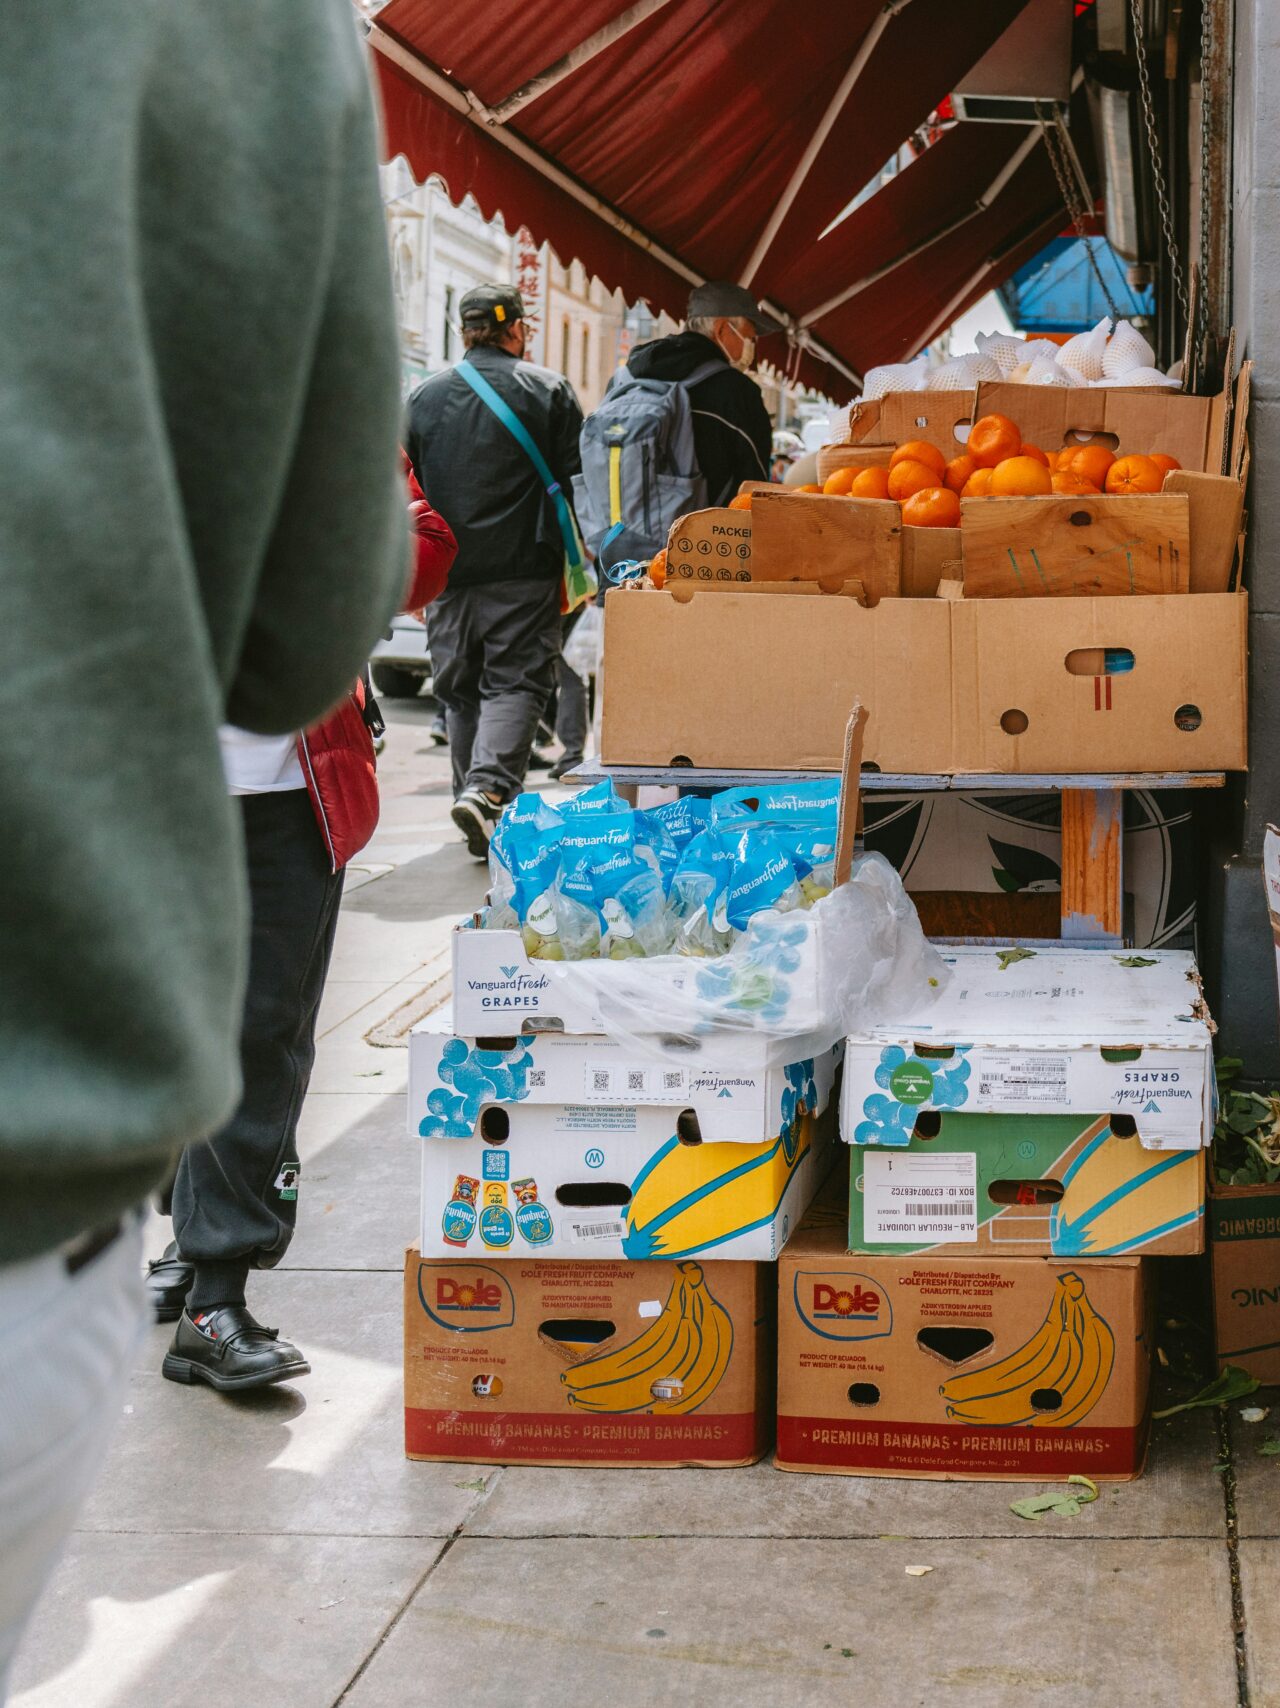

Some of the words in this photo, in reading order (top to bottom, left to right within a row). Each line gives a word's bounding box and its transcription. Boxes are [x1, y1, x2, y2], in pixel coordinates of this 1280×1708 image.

[559, 835, 607, 848] Vanguard
[766, 851, 789, 879] Fresh
[468, 979, 516, 992] Vanguard
[516, 973, 550, 992] Fresh
[481, 996, 539, 1007] GRAPES
[1124, 1072, 1180, 1082] GRAPES
[718, 1078, 756, 1089] Vanguard
[1114, 1088, 1146, 1105] Fresh
[1146, 1088, 1193, 1099] Vanguard
[945, 1188, 957, 1196] ID:
[960, 1188, 975, 1196] BOX
[444, 1205, 477, 1225] Chiquita
[517, 1207, 550, 1225] Chiquita
[877, 1223, 916, 1232] LIQUIDATE
[918, 1223, 953, 1232] REGULAR
[960, 1223, 975, 1231] ALB
[521, 1270, 539, 1279] DOLE
[540, 1271, 566, 1279] FRESH
[567, 1271, 592, 1279] FRUIT
[593, 1271, 634, 1280] COMPANY
[541, 1279, 583, 1287] CHARLOTTE,
[899, 1278, 922, 1286] DOLE
[922, 1278, 947, 1286] FRESH
[948, 1279, 972, 1287] FRUIT
[972, 1280, 1015, 1289] COMPANY
[437, 1278, 503, 1307] Dole
[920, 1288, 961, 1296] CHARLOTTE,
[813, 1284, 881, 1316] Dole
[436, 1421, 502, 1438] PREMIUM
[506, 1423, 572, 1438] BANANAS
[583, 1424, 650, 1440] PREMIUM
[654, 1425, 723, 1440] BANANAS
[812, 1428, 880, 1447] PREMIUM
[883, 1431, 951, 1450] BANANAS
[961, 1435, 1032, 1453] PREMIUM
[1034, 1437, 1105, 1454] BANANAS
